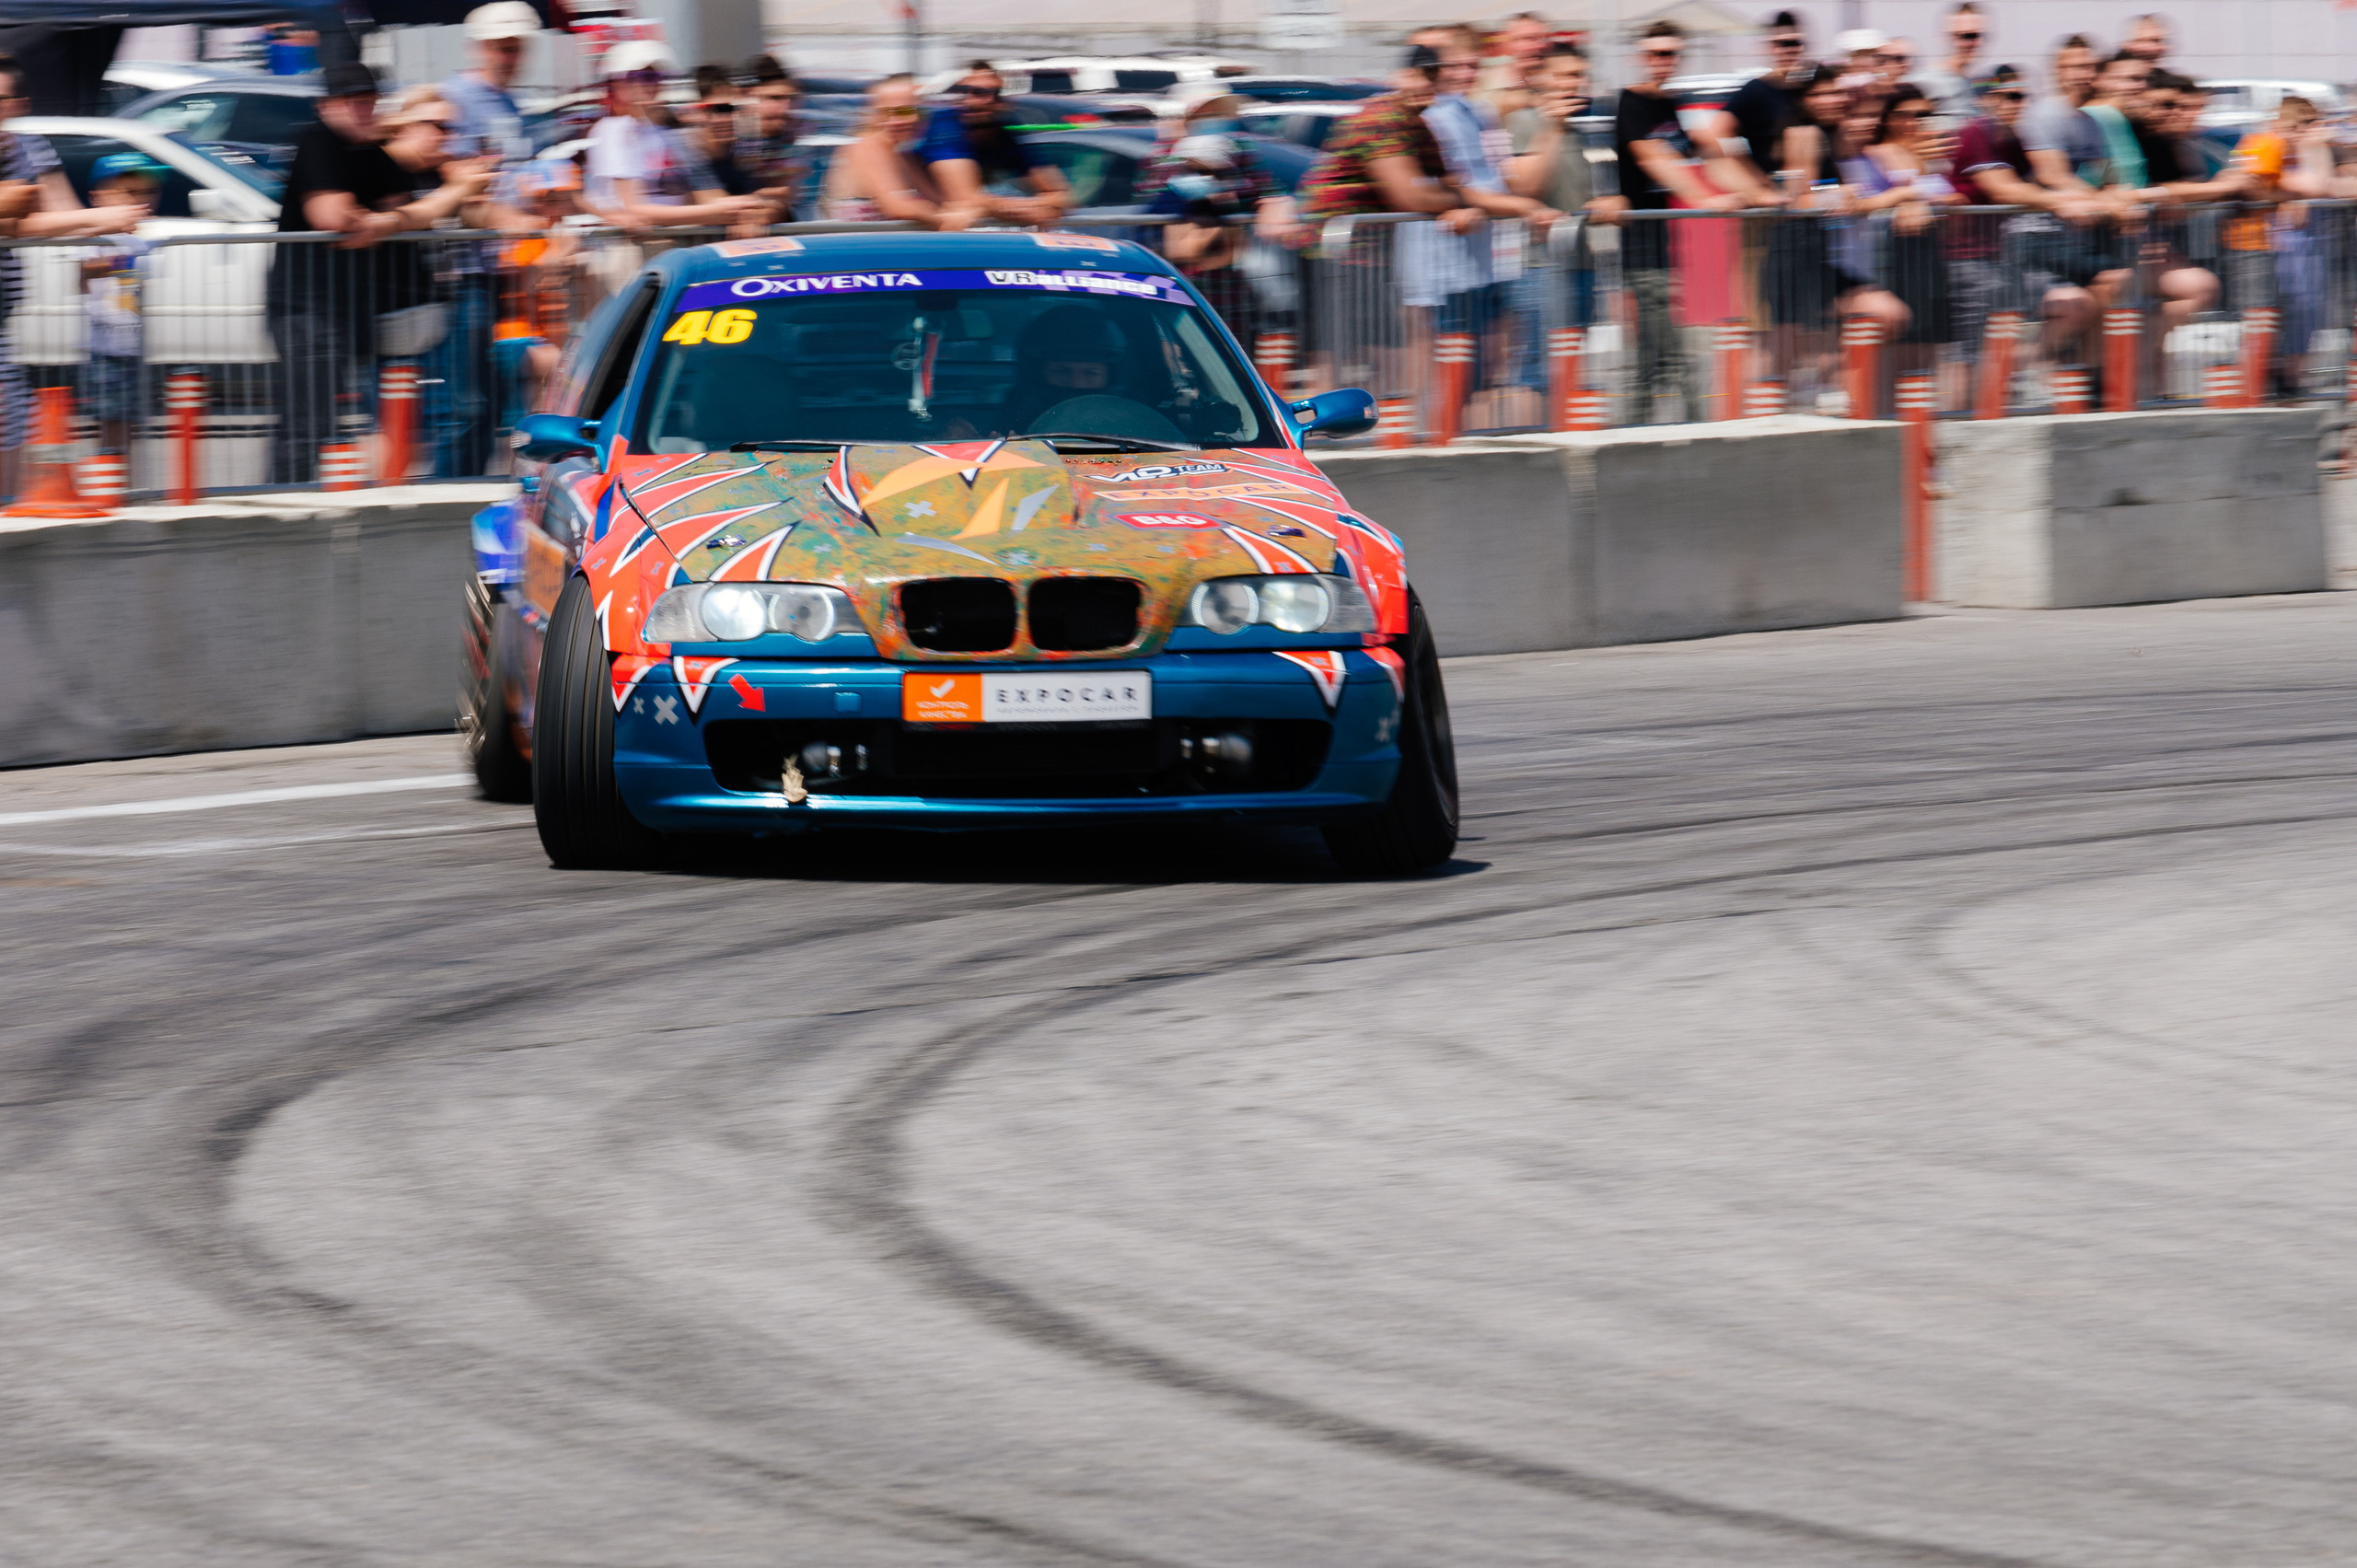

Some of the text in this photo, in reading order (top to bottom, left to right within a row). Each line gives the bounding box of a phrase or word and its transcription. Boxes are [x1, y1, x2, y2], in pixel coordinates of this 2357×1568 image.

[731, 273, 923, 296] OXIVENTA
[662, 308, 758, 345] 46
[1174, 463, 1223, 473] TEAM
[1108, 483, 1294, 498] EXPOCAR
[996, 687, 1139, 703] EXPOCAR
